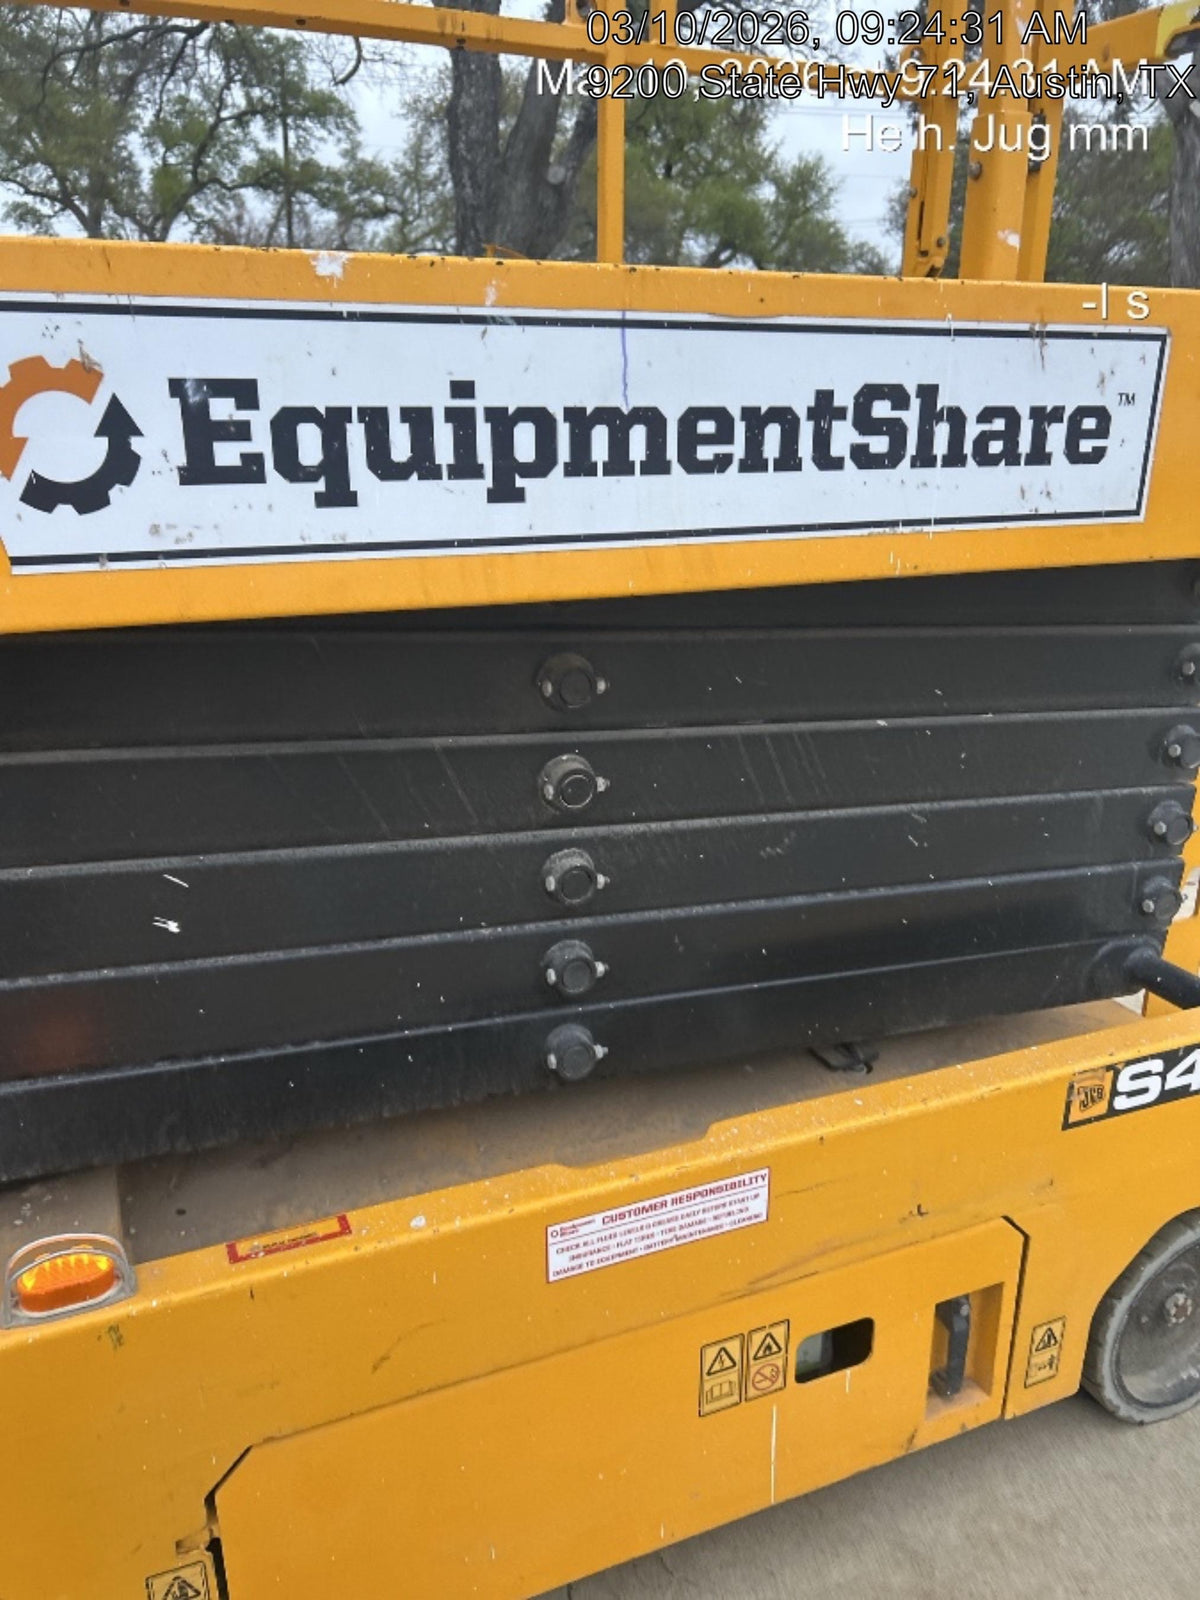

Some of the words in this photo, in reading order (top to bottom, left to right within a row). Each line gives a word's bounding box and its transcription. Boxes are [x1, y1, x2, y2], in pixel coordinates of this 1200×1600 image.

[168, 378, 1111, 508] EquipmentShare
[602, 1200, 668, 1225] CUSTOMER
[671, 1173, 767, 1207] RESPONSIBILITY
